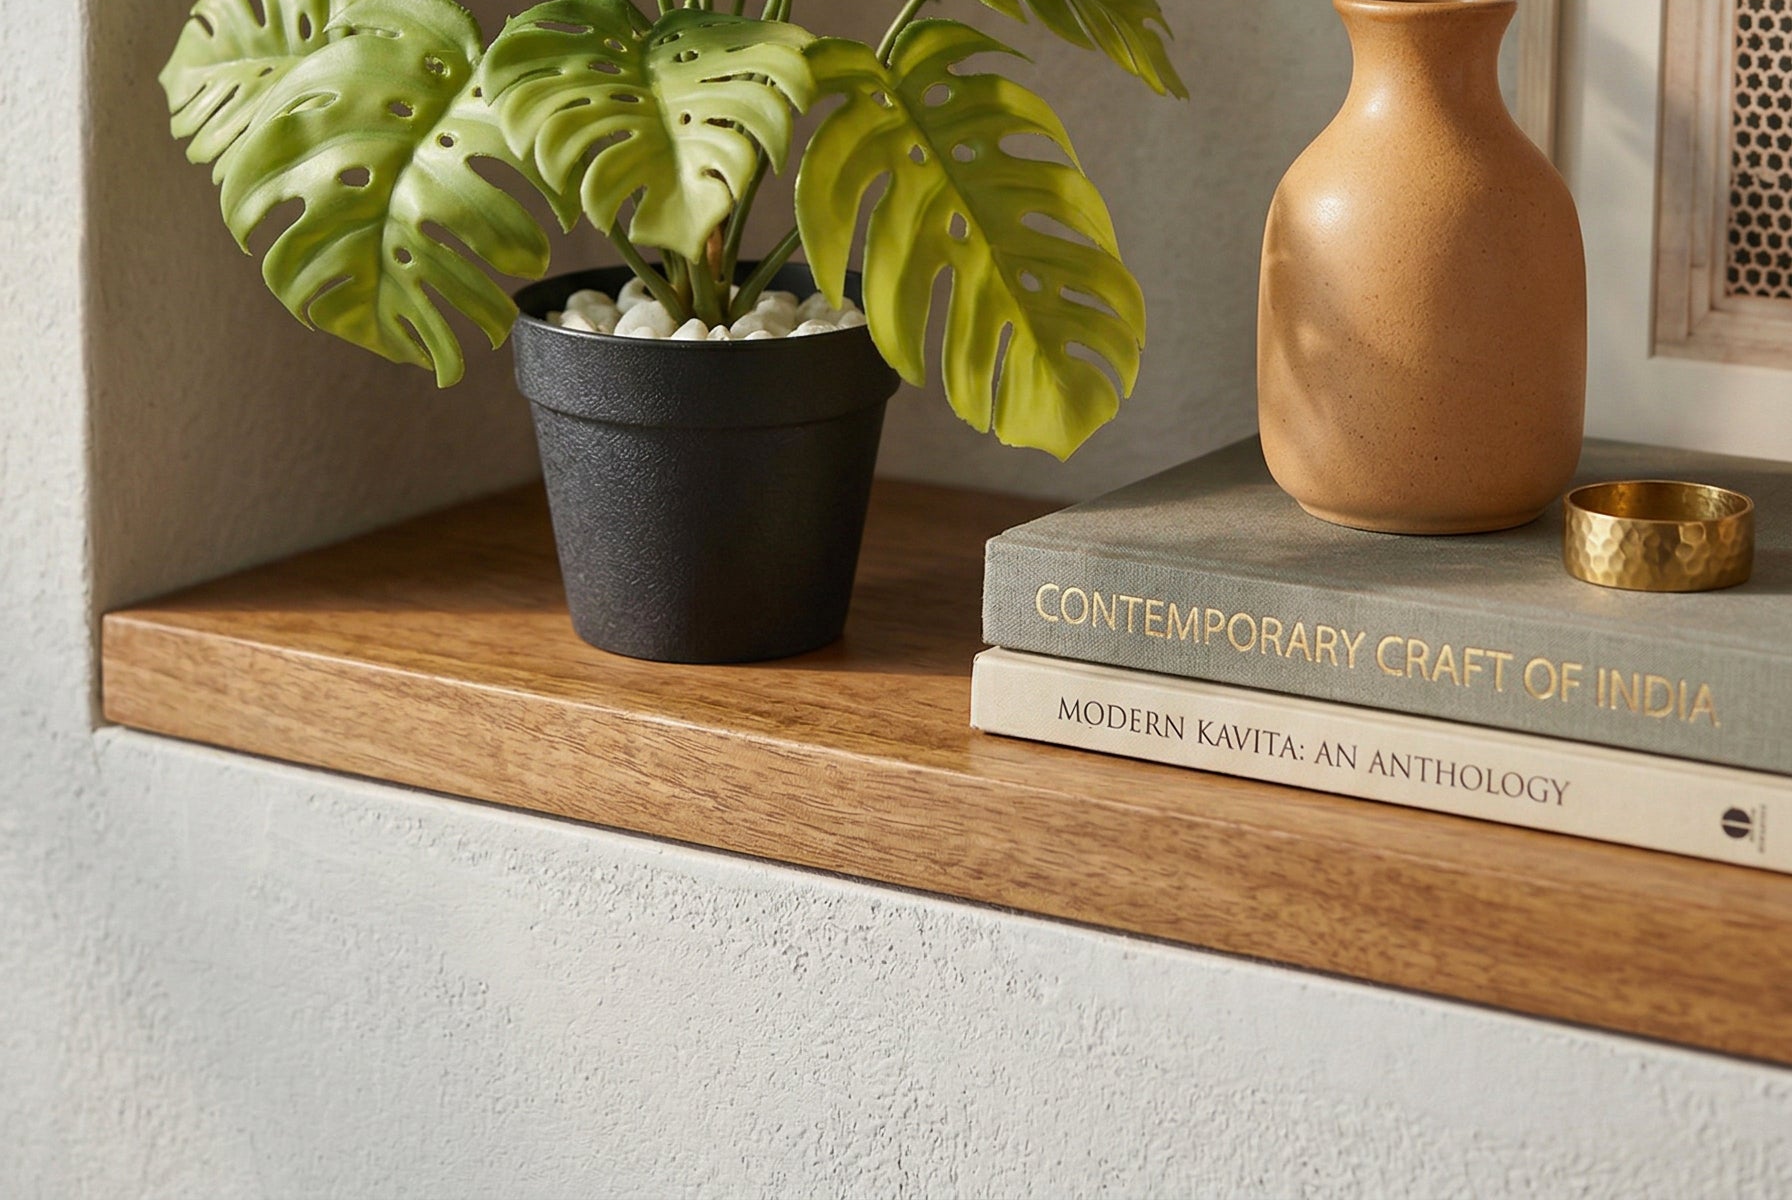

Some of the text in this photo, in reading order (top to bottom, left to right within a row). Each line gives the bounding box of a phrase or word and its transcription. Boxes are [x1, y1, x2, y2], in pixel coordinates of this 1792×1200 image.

[1035, 583, 1721, 727] CONTEMPORARY CRAFT OF INDIA
[1057, 696, 1571, 807] MODERN KAVITA: AN ANTHOLOGY
